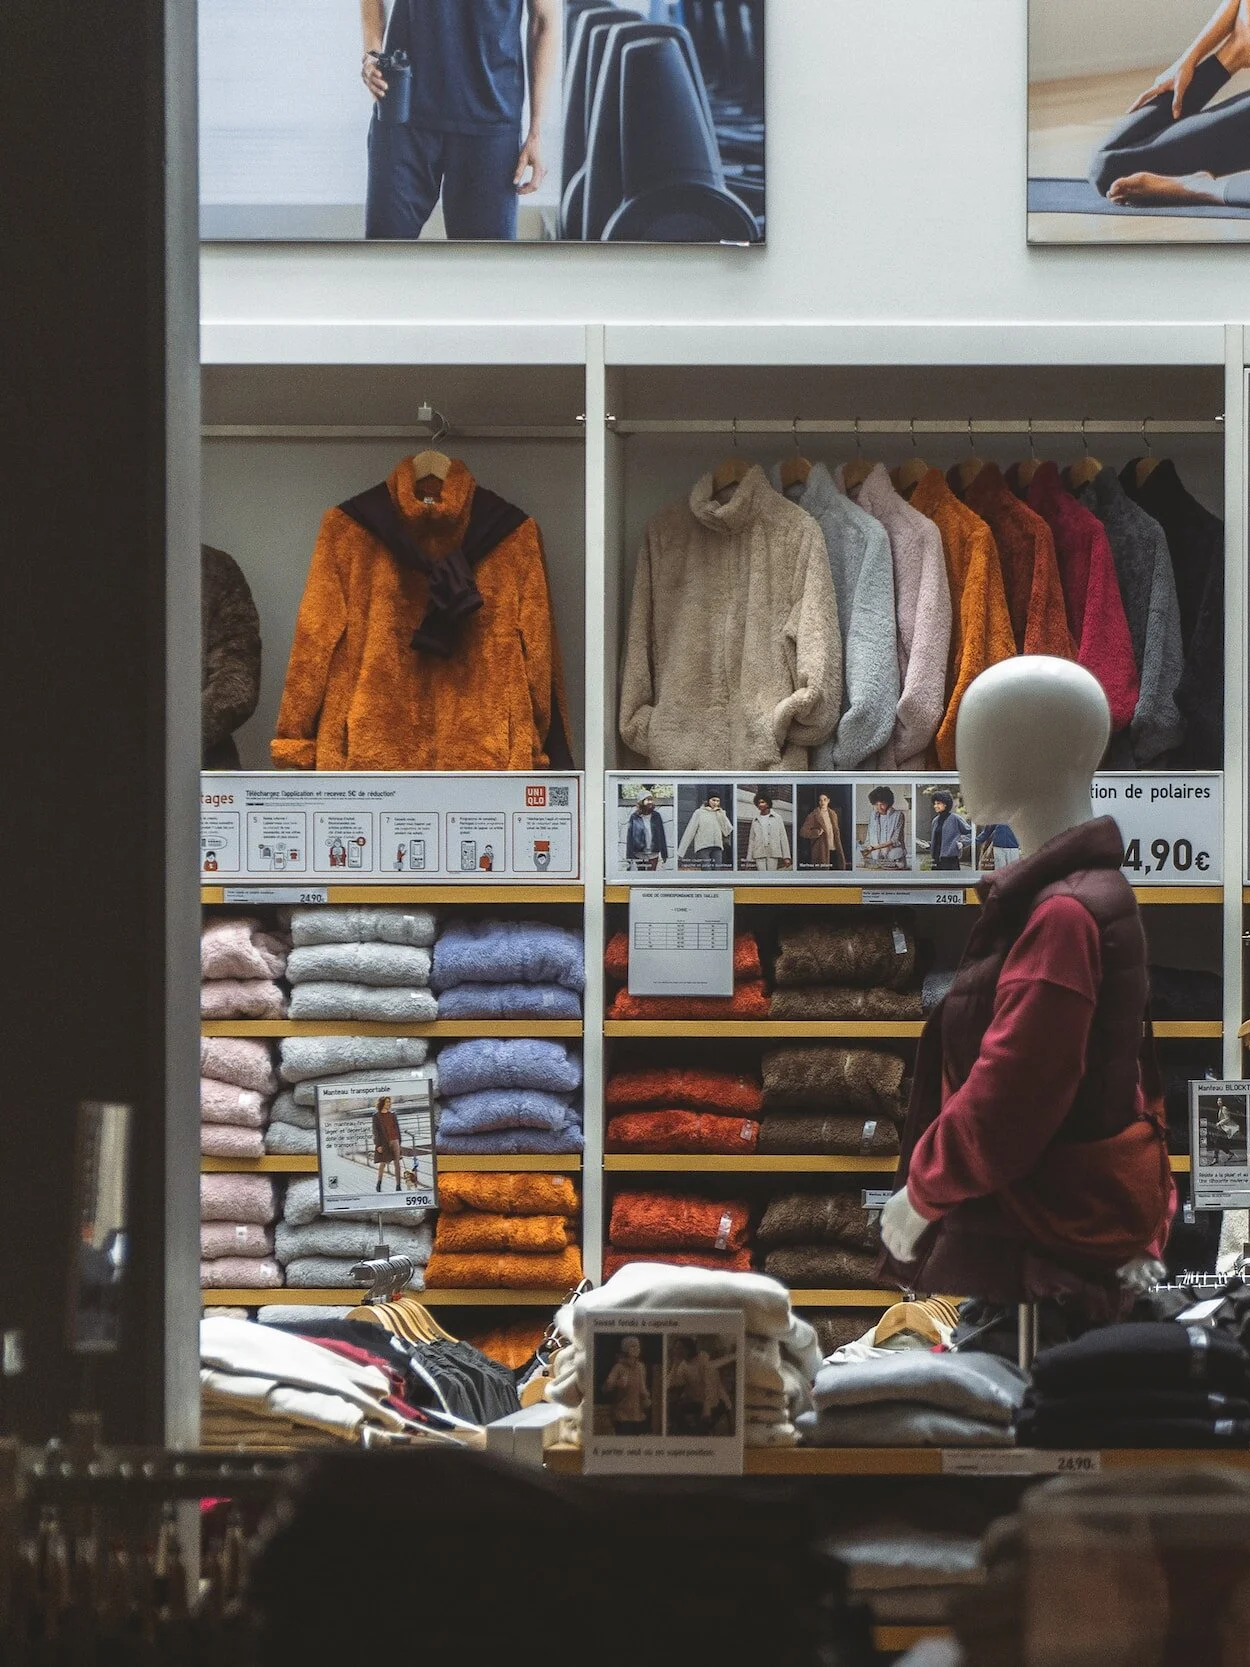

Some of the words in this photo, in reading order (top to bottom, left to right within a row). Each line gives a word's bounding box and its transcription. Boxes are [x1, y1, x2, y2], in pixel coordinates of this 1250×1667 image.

[527, 788, 544, 796] UNI
[1091, 784, 1117, 799] tion
[1125, 784, 1143, 799] de
[1151, 784, 1211, 803] polaires
[527, 797, 545, 805] QLO
[1122, 838, 1210, 875] 4,90€
[323, 1088, 348, 1096] Manteau
[350, 1086, 391, 1095] transportable
